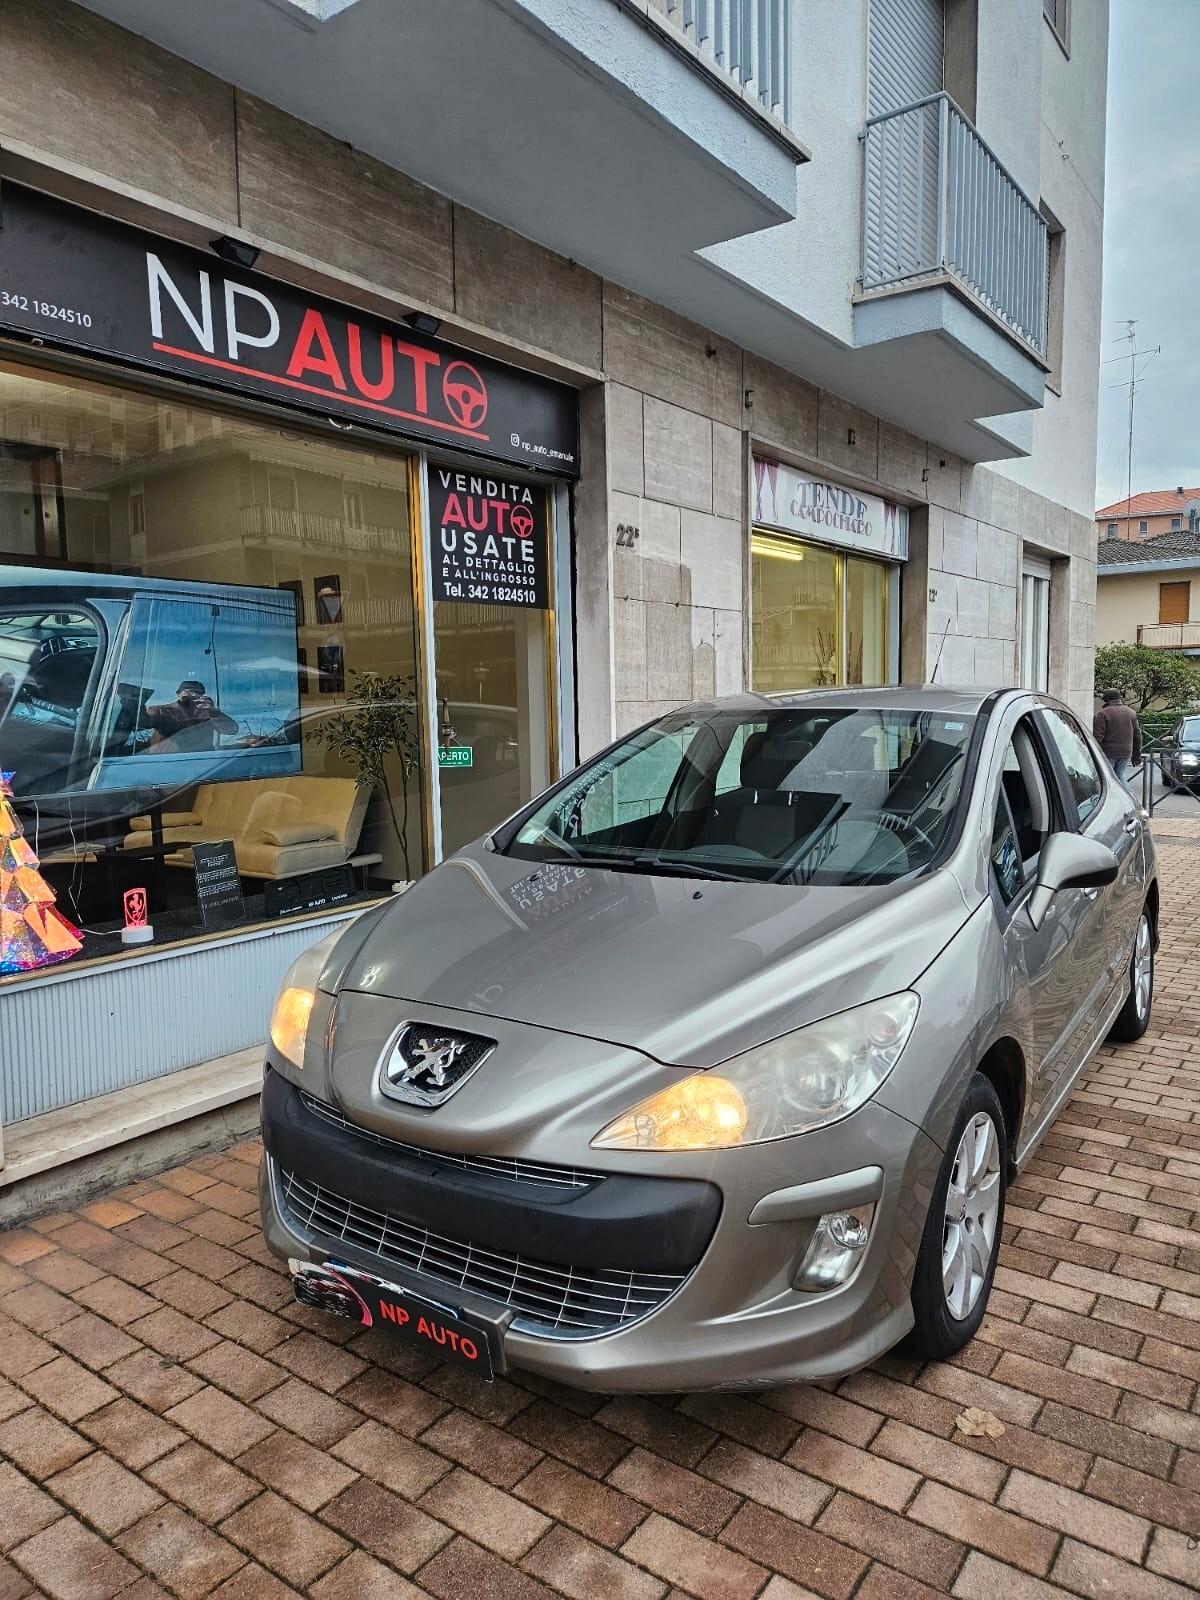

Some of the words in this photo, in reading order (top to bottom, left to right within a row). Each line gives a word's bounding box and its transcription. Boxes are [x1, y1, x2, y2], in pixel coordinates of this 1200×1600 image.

[1, 291, 29, 311] 342
[33, 300, 92, 328] 1824510
[146, 252, 280, 360] NP
[439, 470, 533, 505] VENDITA
[441, 527, 535, 562] USATE
[442, 554, 459, 565] AL
[465, 556, 535, 575] DETTAGLIO
[442, 567, 449, 577] E
[454, 569, 535, 586] ALL'INGROSSO
[443, 582, 465, 598] Tel.
[468, 584, 489, 602] 342
[492, 586, 536, 604] 1824510
[379, 1299, 410, 1327] NP
[417, 1317, 478, 1360] AUTO
